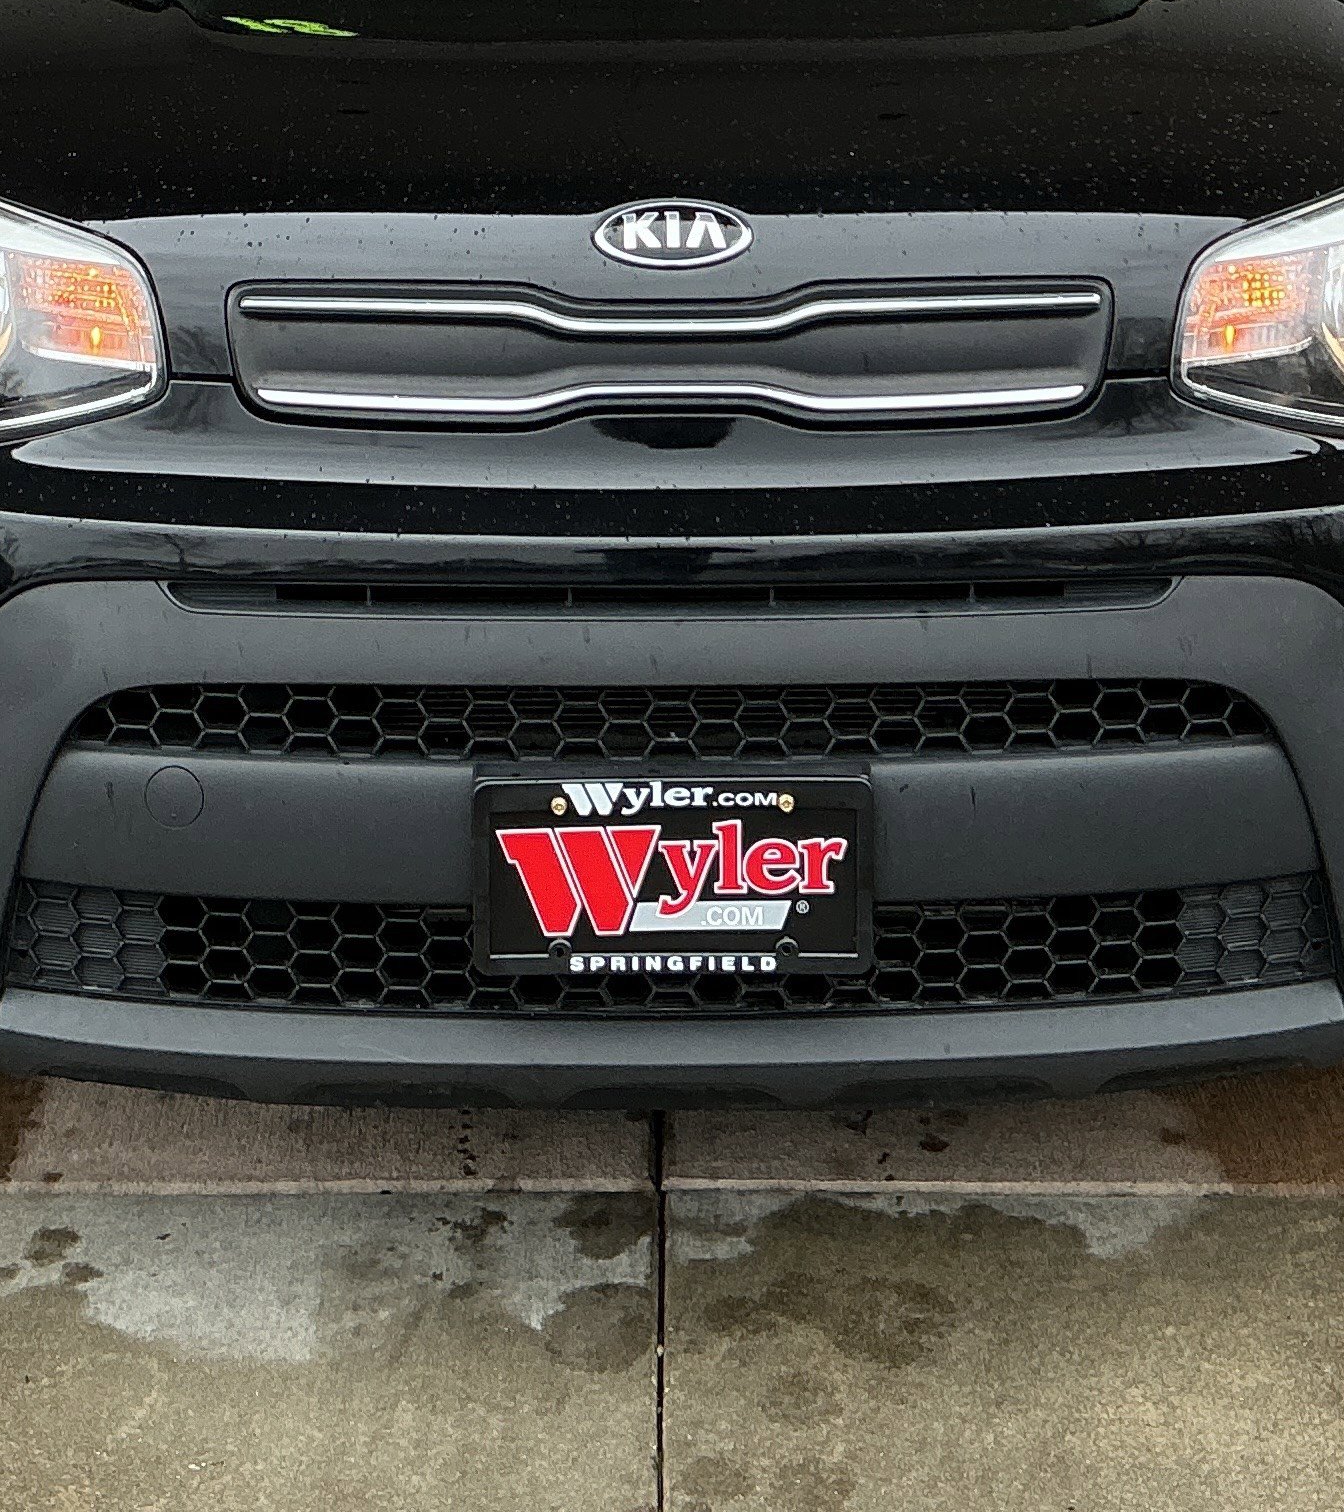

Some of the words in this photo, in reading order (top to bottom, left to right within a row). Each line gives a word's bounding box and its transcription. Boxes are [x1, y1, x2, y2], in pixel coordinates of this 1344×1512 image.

[621, 210, 727, 250] KIA
[495, 819, 849, 937] Wyler
[569, 955, 777, 973] SPRINGFIELD
